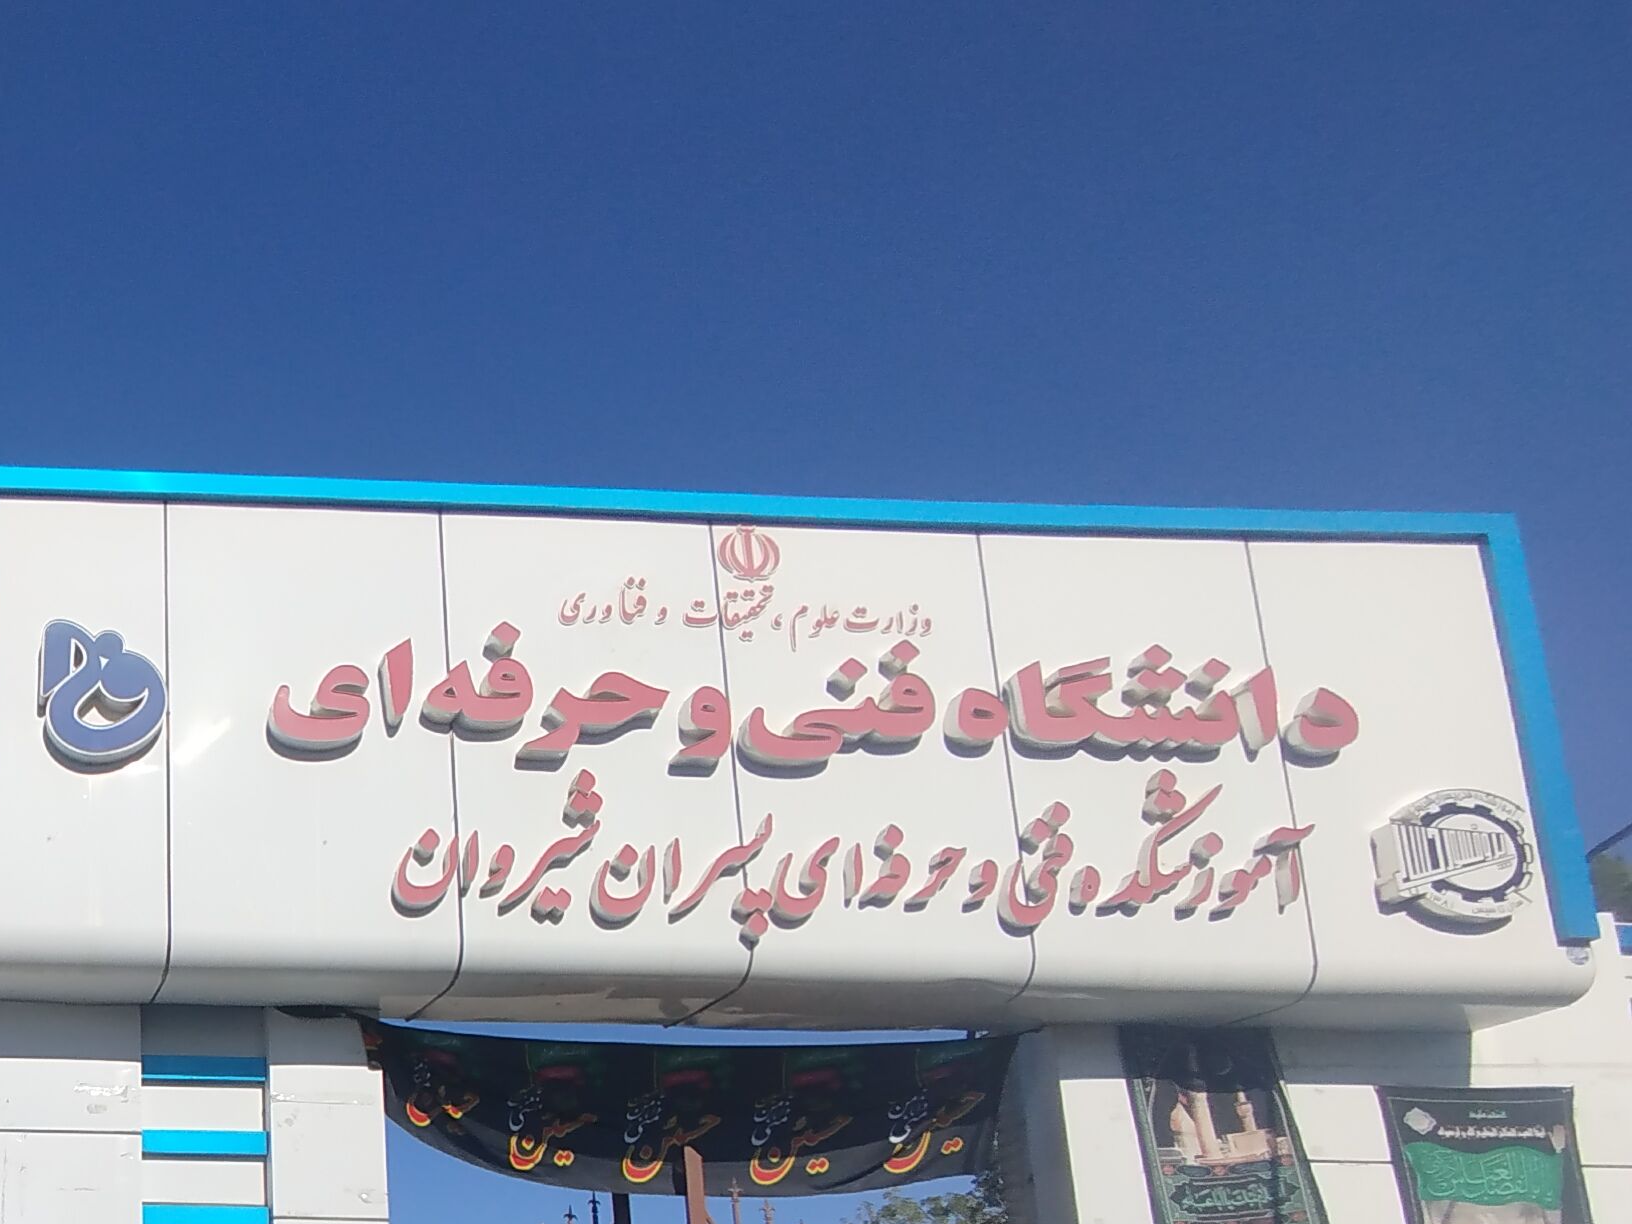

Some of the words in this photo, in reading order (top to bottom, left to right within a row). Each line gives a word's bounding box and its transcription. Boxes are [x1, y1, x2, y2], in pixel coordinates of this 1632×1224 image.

[654, 602, 669, 626] و
[682, 583, 776, 642] تحقیقات
[843, 603, 934, 637] وزارت
[667, 685, 733, 778] و
[737, 639, 937, 779] فنی
[943, 643, 1360, 768] دانشگاه
[391, 768, 603, 925] شیروان
[589, 812, 774, 951] پسران
[961, 858, 999, 914] و
[996, 801, 1075, 938] فنی
[1068, 768, 1315, 922] آموزشکده
